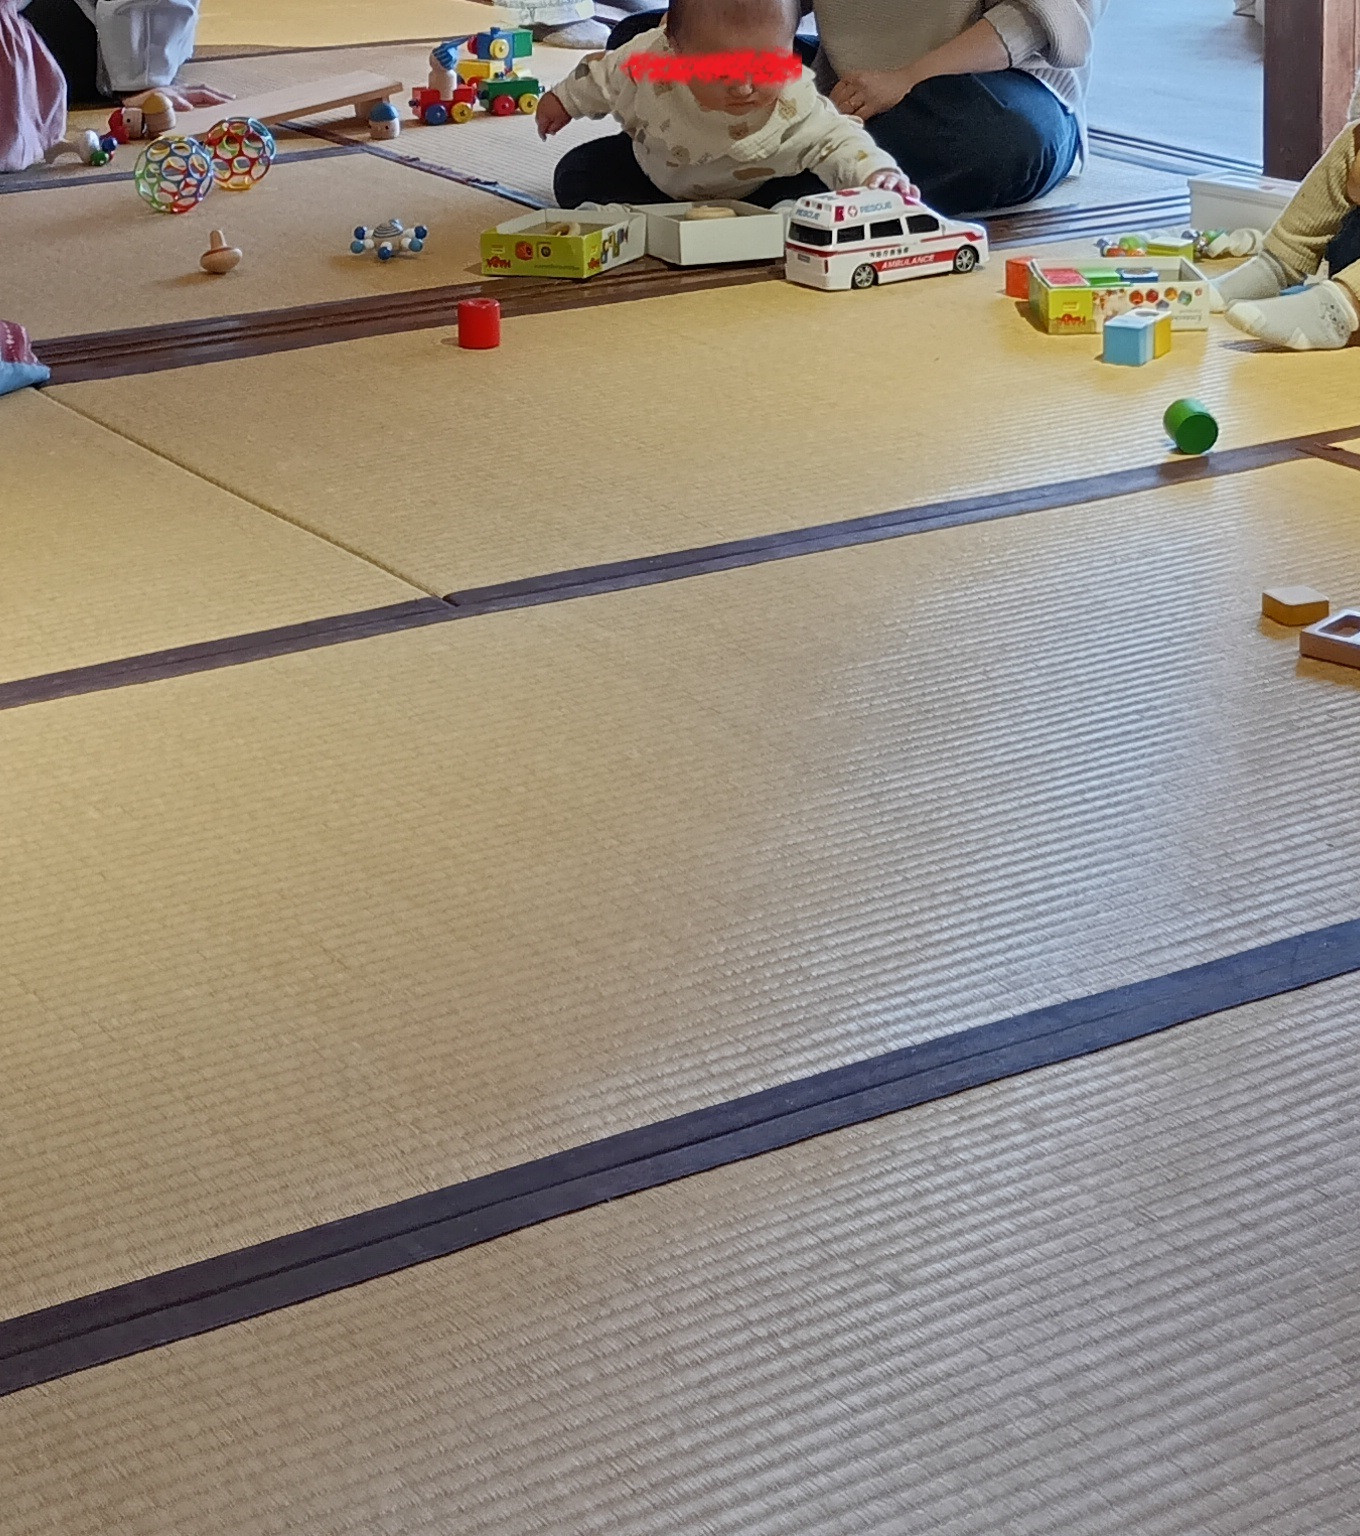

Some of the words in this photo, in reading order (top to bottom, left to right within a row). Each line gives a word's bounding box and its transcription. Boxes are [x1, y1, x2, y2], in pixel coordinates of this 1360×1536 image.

[860, 202, 893, 213] RESCUE
[796, 209, 820, 221] RESCUE
[881, 255, 936, 270] AMBULANCE
